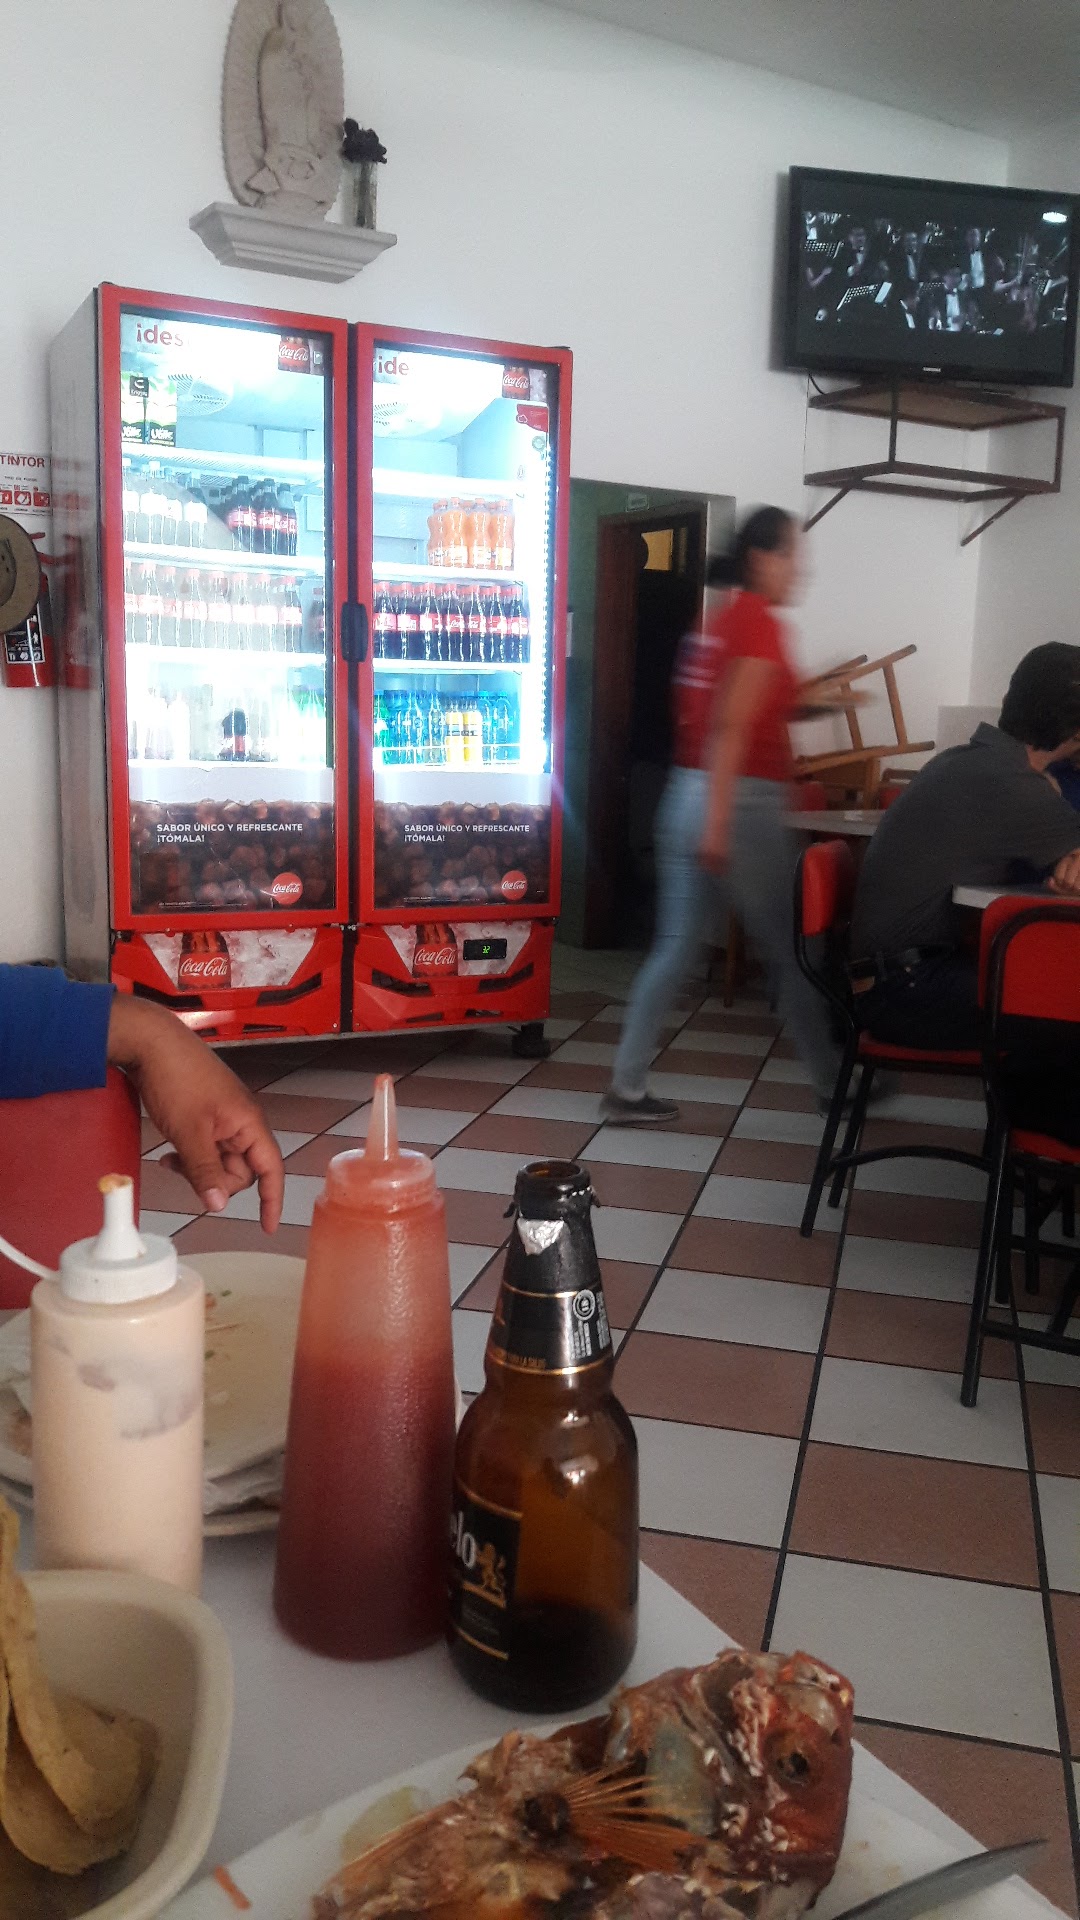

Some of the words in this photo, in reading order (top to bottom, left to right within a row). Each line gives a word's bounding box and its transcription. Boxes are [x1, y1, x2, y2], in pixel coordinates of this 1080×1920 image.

[156, 824, 191, 832] SABOR
[194, 822, 225, 832] ÚNICO
[227, 824, 234, 832] Y
[237, 823, 303, 832] REFRESCANTE
[404, 824, 434, 832] SABOR
[436, 823, 463, 832] ÚNICO
[465, 824, 471, 832] Y
[472, 824, 530, 832] REFRESCANTE
[156, 833, 205, 844] ¡TÓMALA!
[404, 833, 445, 843] ¡TÓMALA!
